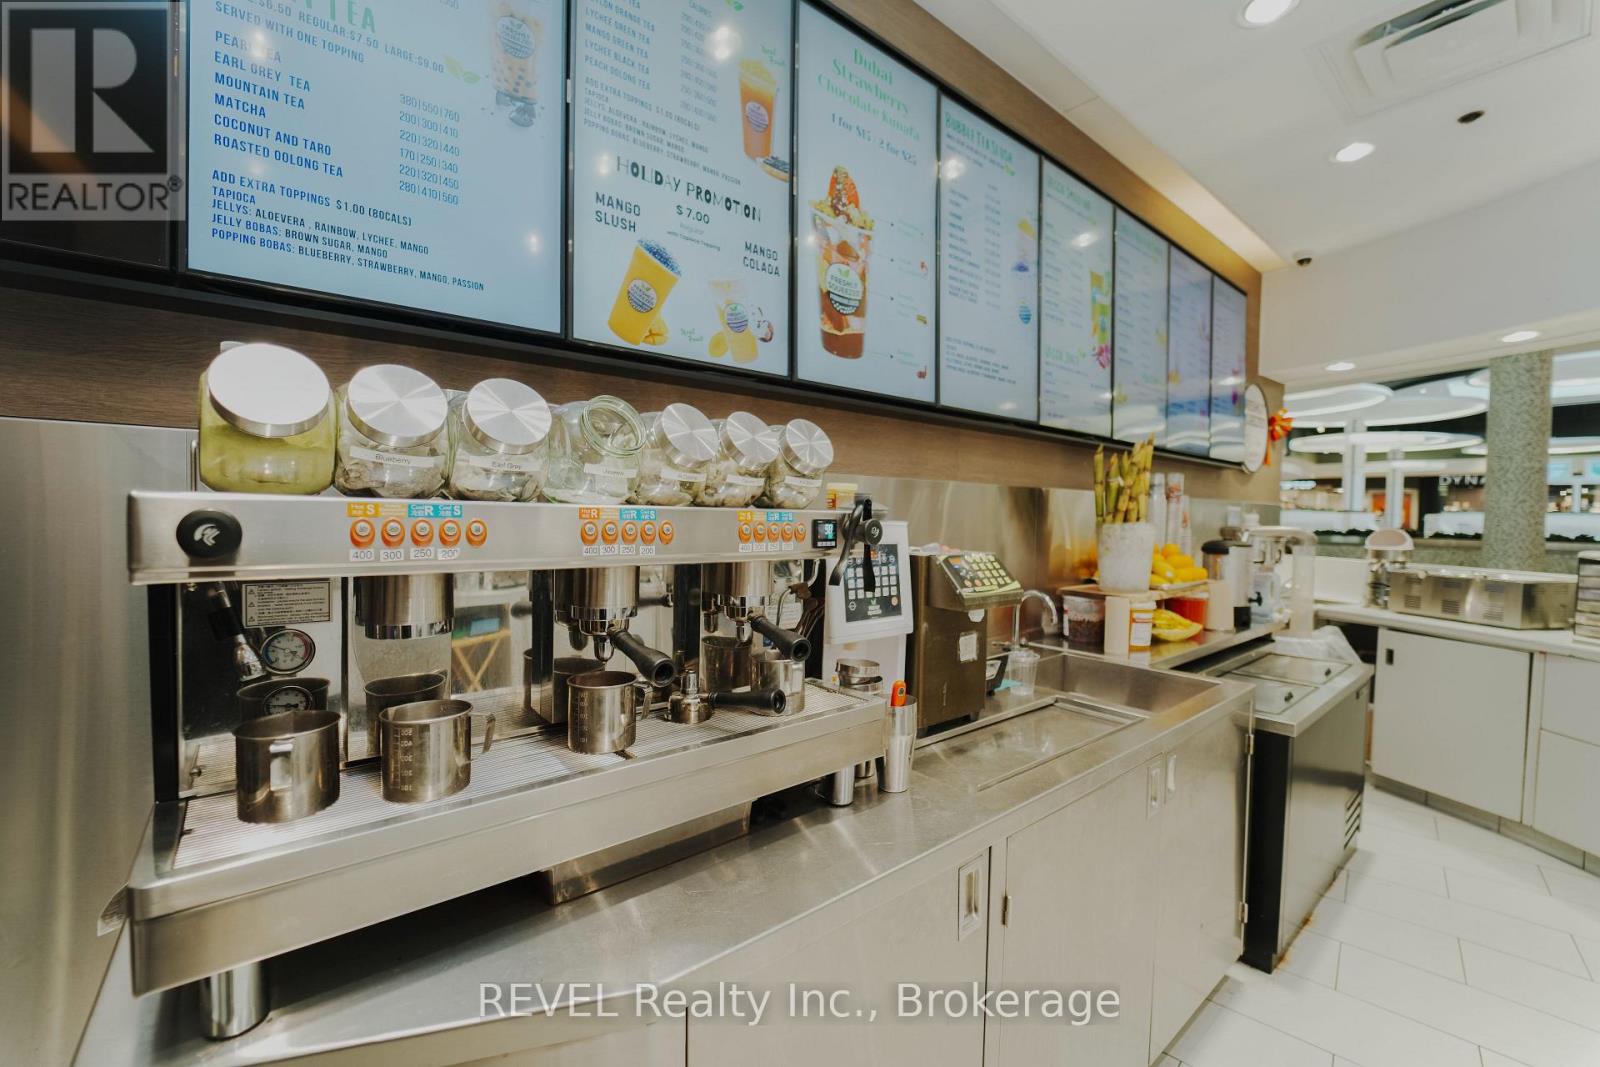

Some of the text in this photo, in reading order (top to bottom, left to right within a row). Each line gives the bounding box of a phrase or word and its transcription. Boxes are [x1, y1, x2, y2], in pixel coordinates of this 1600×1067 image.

[215, 2, 365, 63] SERVED WITH ONE TOPPING
[215, 30, 252, 53] PEAR
[214, 50, 311, 92] EARL GREY TEA
[853, 47, 893, 85] Dubai
[214, 72, 305, 110] MOUNTAIN TEA
[832, 58, 908, 118] Strawberry
[214, 93, 266, 118] MATCHA
[214, 113, 332, 156] COCONUT AND TARO
[838, 116, 852, 131] for
[214, 133, 343, 178] ROASTED OOLONG TEA
[212, 169, 236, 184] ADD
[239, 176, 276, 195] EXTRA
[279, 185, 331, 207] TOPPINGS
[336, 199, 365, 216] $1.00
[212, 186, 256, 205] TAPIOCA
[616, 155, 762, 222] HOLIDAY PROMOTION
[595, 191, 641, 217] MANGO
[211, 198, 252, 216] JELLYS:
[255, 208, 305, 228] ALOEVERA
[400, 240, 429, 255] MANGO
[595, 210, 637, 233] SLUSH
[211, 213, 242, 228] JELLY
[245, 220, 282, 237] BOBAS:
[285, 228, 319, 245] BROWN
[357, 244, 388, 259] MANGO
[211, 227, 256, 246] POPPING
[259, 238, 295, 254] BOBAS:
[452, 276, 484, 291] PASSION
[744, 241, 778, 261] MANGO
[742, 255, 781, 277] COLADA
[366, 503, 375, 515] S
[424, 504, 434, 516] R
[453, 504, 461, 515] S
[591, 508, 598, 518] R
[352, 550, 373, 560] 400
[383, 550, 402, 560] 300
[413, 548, 432, 558] 250
